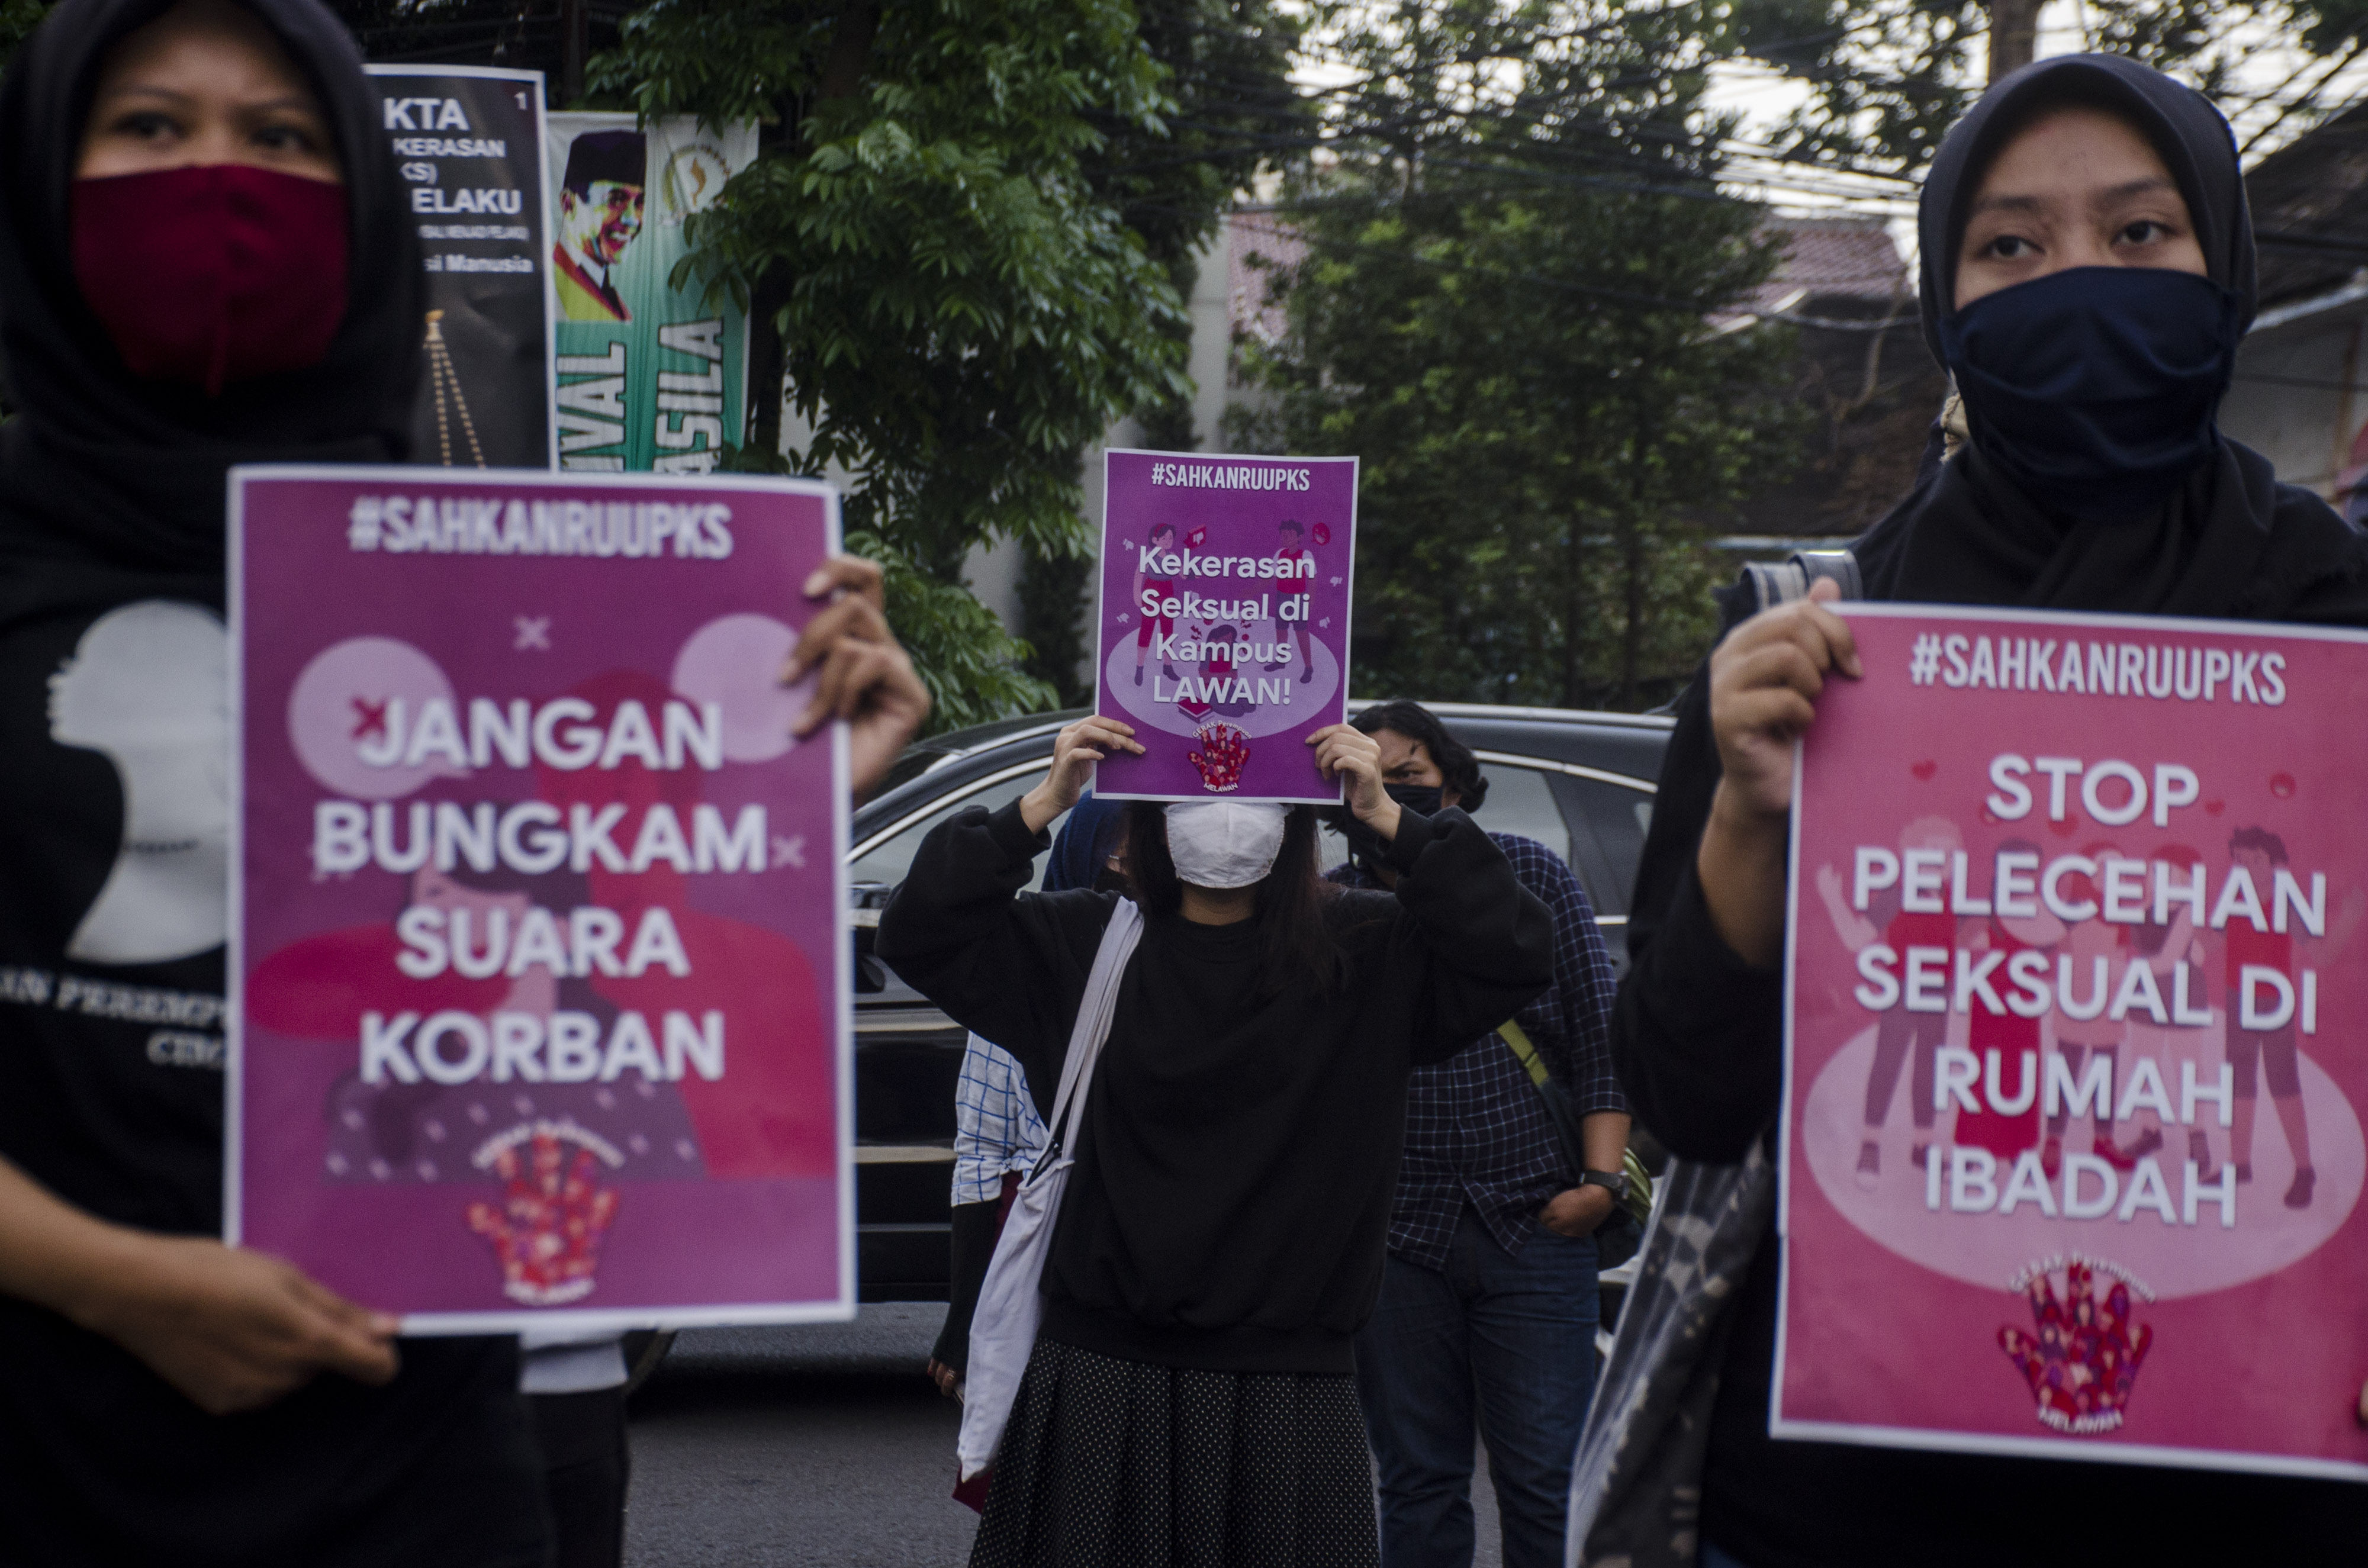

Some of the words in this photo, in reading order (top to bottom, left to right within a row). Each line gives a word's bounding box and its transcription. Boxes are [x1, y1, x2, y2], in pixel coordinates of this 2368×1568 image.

[383, 98, 471, 131] KTA
[514, 91, 527, 111] 1
[392, 137, 506, 158] KERASAN
[411, 188, 522, 215] ELAKU
[1151, 462, 1310, 491] #SAHKANRUUPKS
[348, 495, 734, 559] #SAHKANRUUPKS
[1139, 545, 1315, 579] Kekerasan
[1140, 588, 1269, 622] Seksual
[1279, 593, 1310, 622] di
[1156, 633, 1292, 669] Kampus
[1910, 633, 2287, 706] #SAHKANRUUPKS
[1154, 675, 1291, 705] LAWAN!
[359, 697, 723, 770] JANGAN
[1192, 722, 1216, 738] GERAK
[1218, 720, 1253, 739] Perempuan
[1204, 783, 1238, 793] MELAWAN
[1986, 752, 2200, 828] STOP
[314, 800, 768, 874] BUNGKAM
[1854, 846, 2327, 936] PELECEHAN
[395, 906, 692, 979] SUARA
[1854, 944, 2214, 1027] SEKSUAL
[2240, 963, 2318, 1034] DI
[359, 1009, 726, 1084] KORBAN
[1932, 1046, 2234, 1128] RUMAH
[1925, 1144, 2237, 1228] IBADAH
